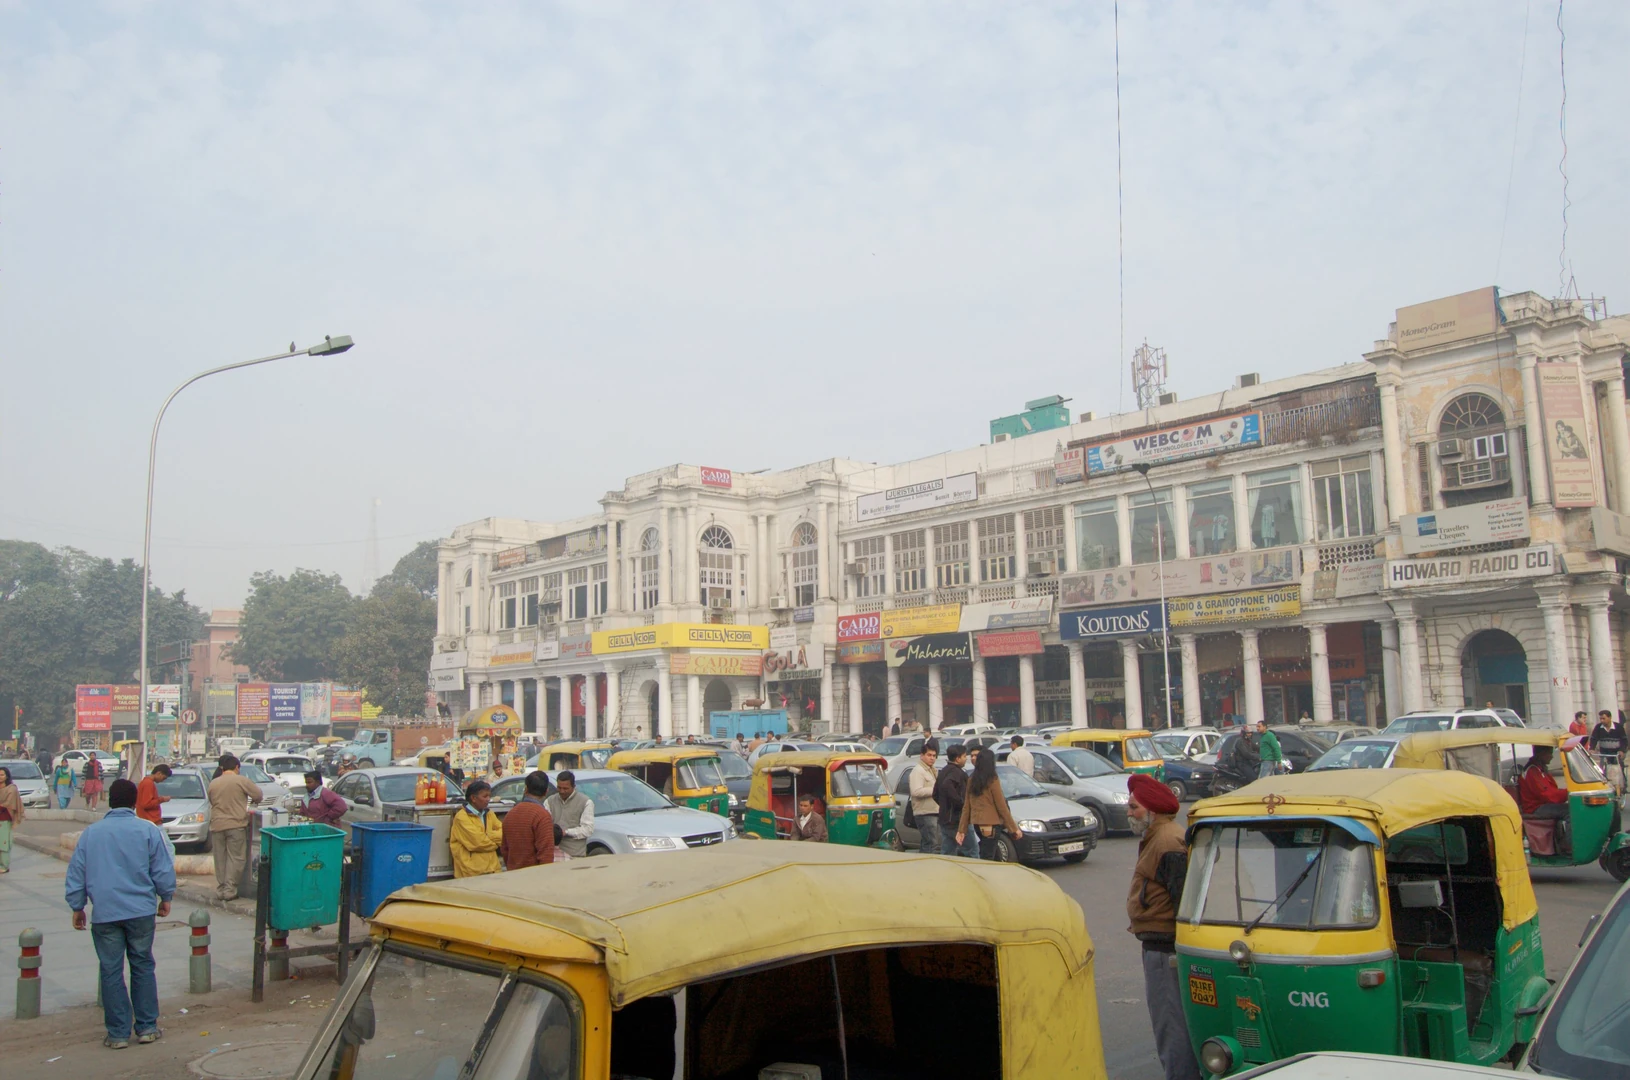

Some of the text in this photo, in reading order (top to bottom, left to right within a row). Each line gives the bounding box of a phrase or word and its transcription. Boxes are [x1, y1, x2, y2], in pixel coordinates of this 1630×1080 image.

[1400, 320, 1456, 338] MoneyGram
[1154, 442, 1193, 454] TECHNOLOGIES
[702, 470, 730, 480] CADD
[702, 476, 730, 484] CENTRE
[888, 482, 942, 498] JURISTA LEGALIS
[1504, 516, 1524, 524] Exchange
[1438, 524, 1469, 534] Travellers
[1438, 532, 1466, 541] Cheques
[1393, 550, 1551, 581] HOWARD RADIO CO.
[1170, 592, 1298, 612] RADIO & GRAMOPHONE HOUSE
[1194, 609, 1223, 617] World
[1240, 605, 1271, 614] Music
[838, 616, 879, 631] CADD
[1076, 610, 1150, 634] KOUTONS
[838, 626, 878, 638] CENTRE
[907, 641, 968, 660] Maharani
[694, 656, 739, 668] CADD
[694, 666, 739, 674] CENTRE
[1553, 677, 1569, 686] K K
[1193, 992, 1214, 1003] 7047
[1288, 990, 1330, 1008] CNG
